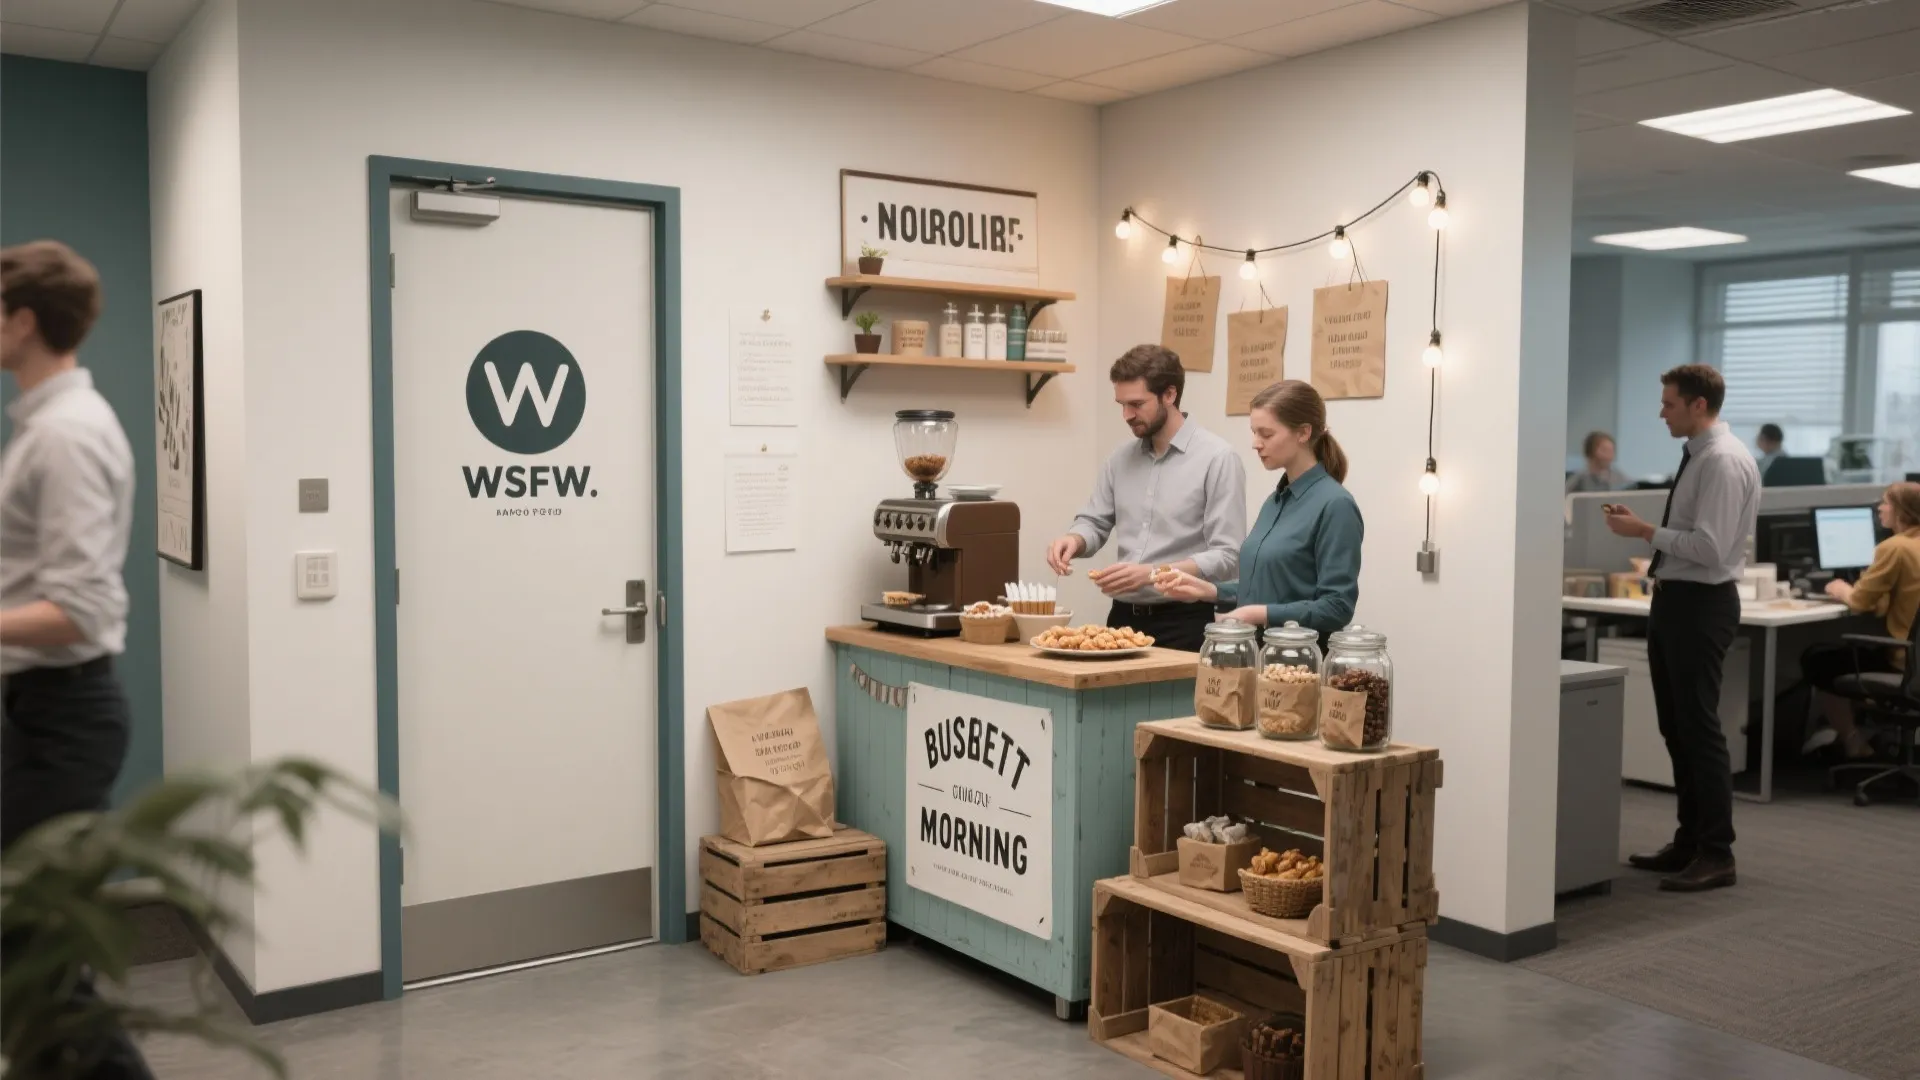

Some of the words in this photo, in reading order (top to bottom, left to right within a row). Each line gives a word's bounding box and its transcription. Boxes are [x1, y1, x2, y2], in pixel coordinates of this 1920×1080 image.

[484, 361, 569, 427] W
[462, 465, 598, 498] WSFW.
[924, 715, 1031, 790] BUSBETT
[920, 806, 1028, 876] MORNING
